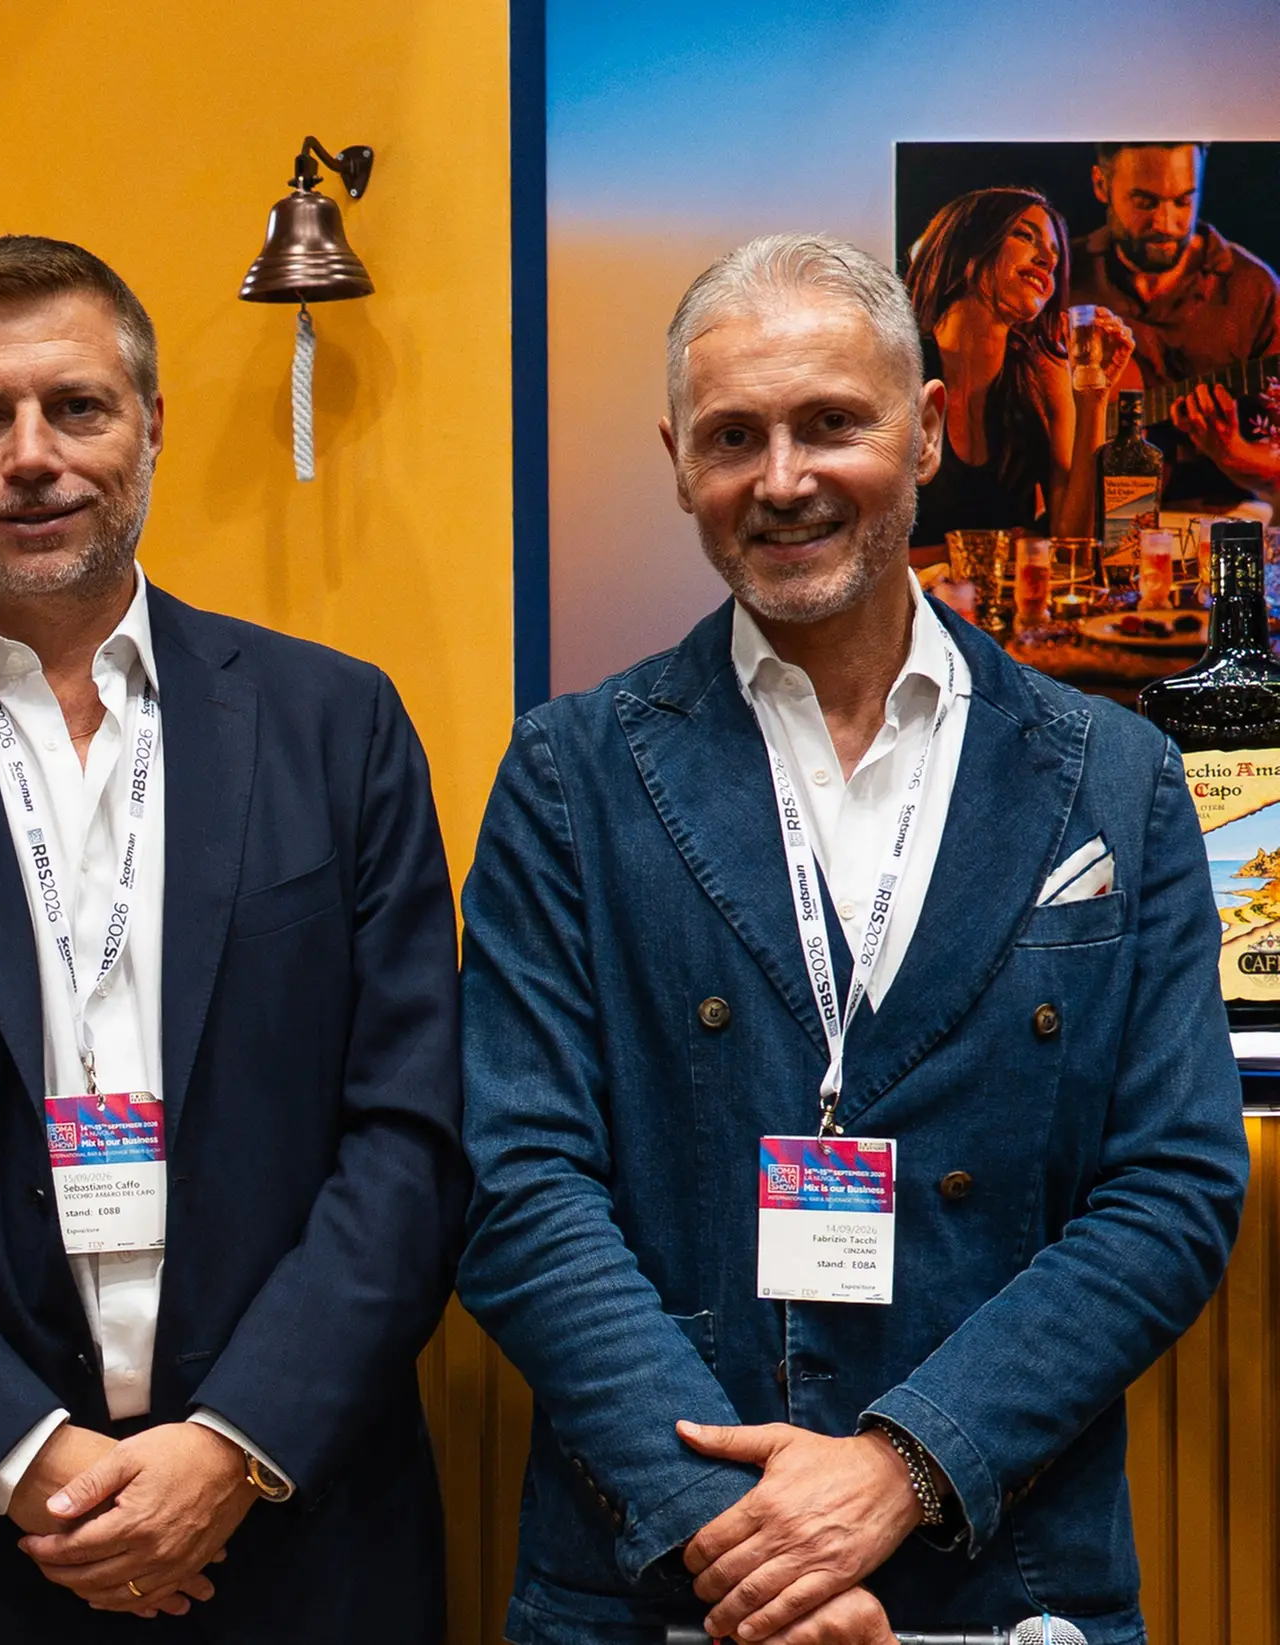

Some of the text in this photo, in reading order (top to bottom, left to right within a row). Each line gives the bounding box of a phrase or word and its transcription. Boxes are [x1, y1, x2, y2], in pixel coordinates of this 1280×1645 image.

[131, 728, 153, 804] RBS2026
[1186, 763, 1232, 778] cchio
[12, 760, 34, 812] Scotsman
[1194, 782, 1242, 801] Capo
[773, 755, 801, 831] RBS2026
[893, 804, 915, 858] Scotsman
[119, 832, 137, 888] Scotsman
[31, 843, 63, 923] RBS2026
[796, 864, 814, 922] Scotsman
[861, 888, 892, 967] RBS2026
[1241, 954, 1280, 973] CAF
[807, 936, 836, 1021] RBS2026
[48, 1124, 73, 1134] ROMA
[49, 1133, 74, 1142] BAR
[81, 1136, 159, 1148] Mix is our Business
[49, 1141, 75, 1150] SHOW
[771, 1166, 797, 1175] ROMA
[63, 1174, 113, 1183] 15/09/2026
[771, 1174, 797, 1184] BAR
[63, 1181, 141, 1193] Sebastiano Caffo
[770, 1183, 797, 1192] SHOW
[803, 1183, 885, 1195] Mix is our Business
[65, 1208, 93, 1218] stand:
[825, 1224, 878, 1235] 14/09/2026
[812, 1234, 878, 1245] Fabrizio Tacchi
[843, 1247, 877, 1255] CINZANO
[817, 1259, 847, 1269] stand:
